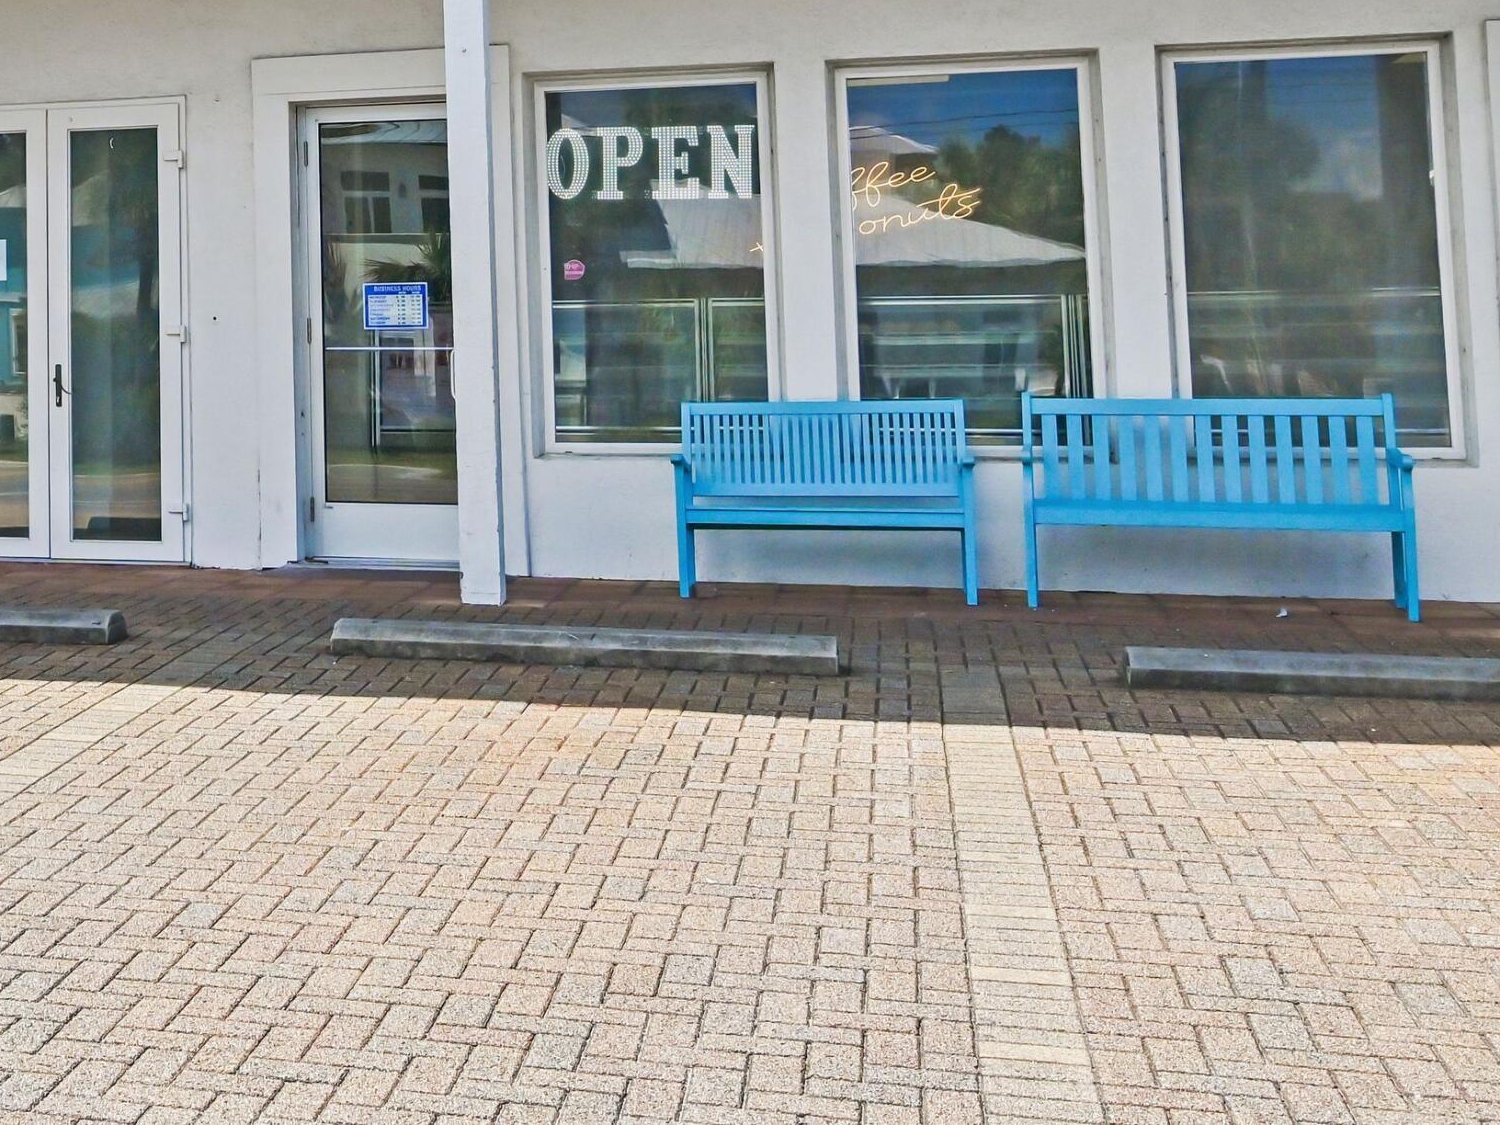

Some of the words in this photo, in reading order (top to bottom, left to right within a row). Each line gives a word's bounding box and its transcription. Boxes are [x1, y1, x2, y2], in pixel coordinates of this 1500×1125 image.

[547, 124, 755, 200] OPEN
[851, 161, 935, 212] ffee
[858, 183, 981, 235] onuts
